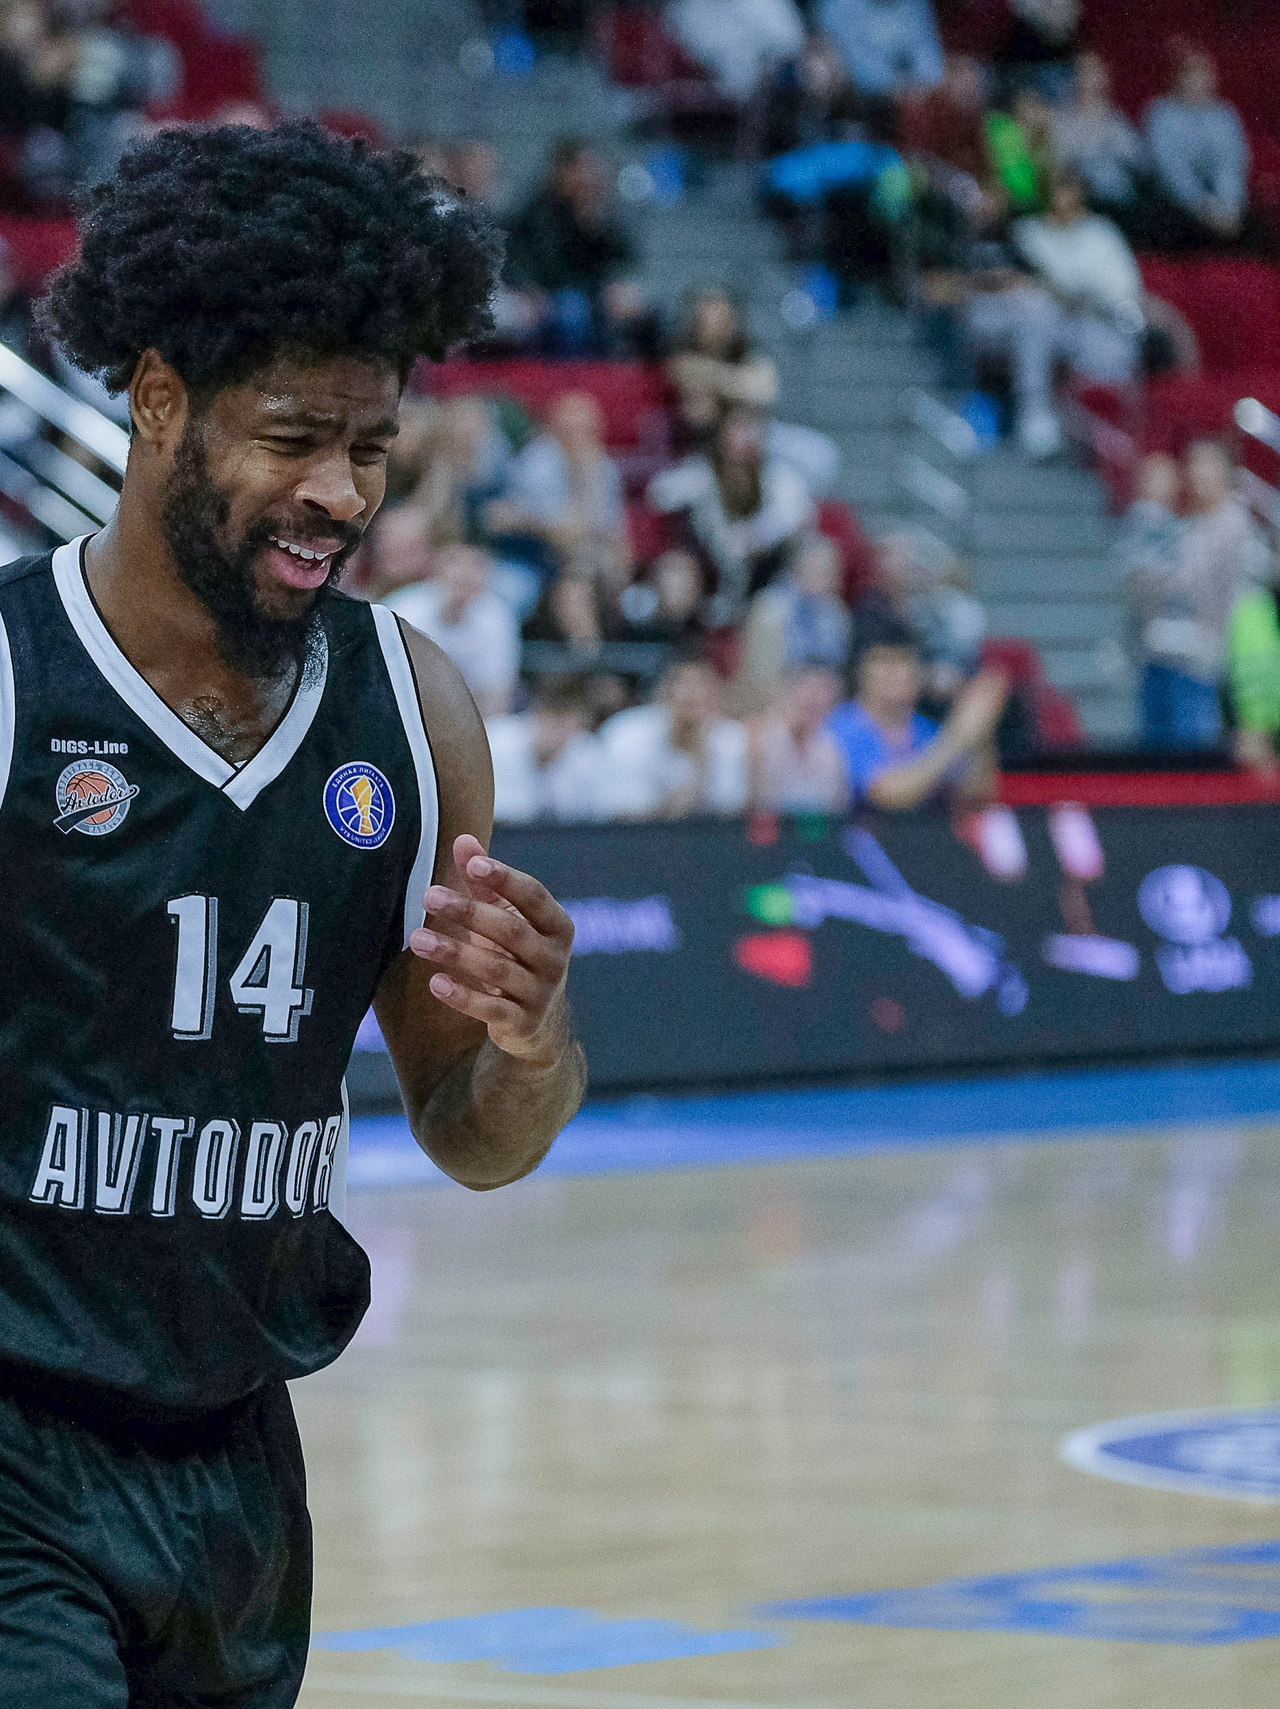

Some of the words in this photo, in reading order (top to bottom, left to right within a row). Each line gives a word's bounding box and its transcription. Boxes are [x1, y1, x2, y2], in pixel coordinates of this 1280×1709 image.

[50, 738, 129, 755] DIGS-Line
[167, 896, 314, 1042] 14
[29, 1105, 342, 1220] AVTODOR
